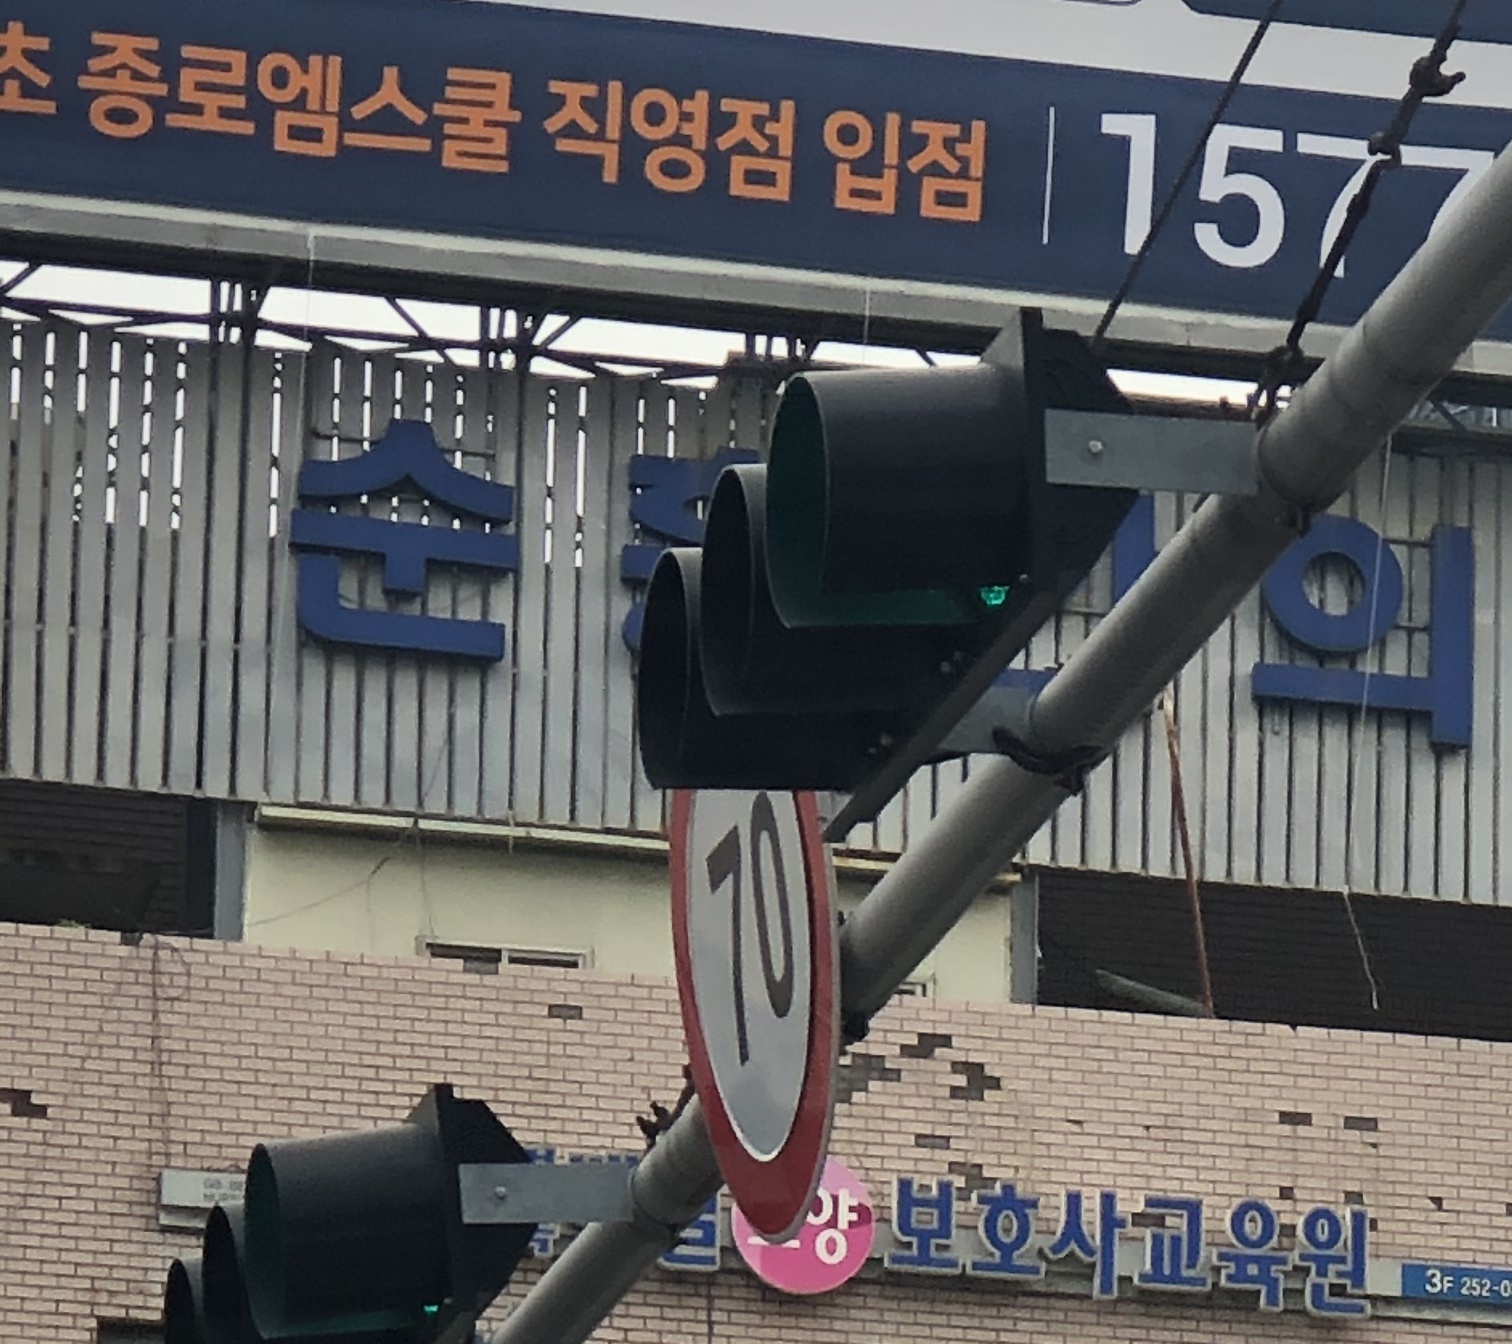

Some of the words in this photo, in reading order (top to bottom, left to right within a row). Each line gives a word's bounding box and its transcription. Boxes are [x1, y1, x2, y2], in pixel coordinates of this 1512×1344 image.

[77, 31, 522, 174] 종로엠스쿨
[544, 77, 795, 202] 직영점
[822, 107, 986, 224] 입점
[706, 791, 794, 1067] 70
[885, 1175, 1372, 1319] 보호사교육원
[1424, 1268, 1454, 1294] 3F
